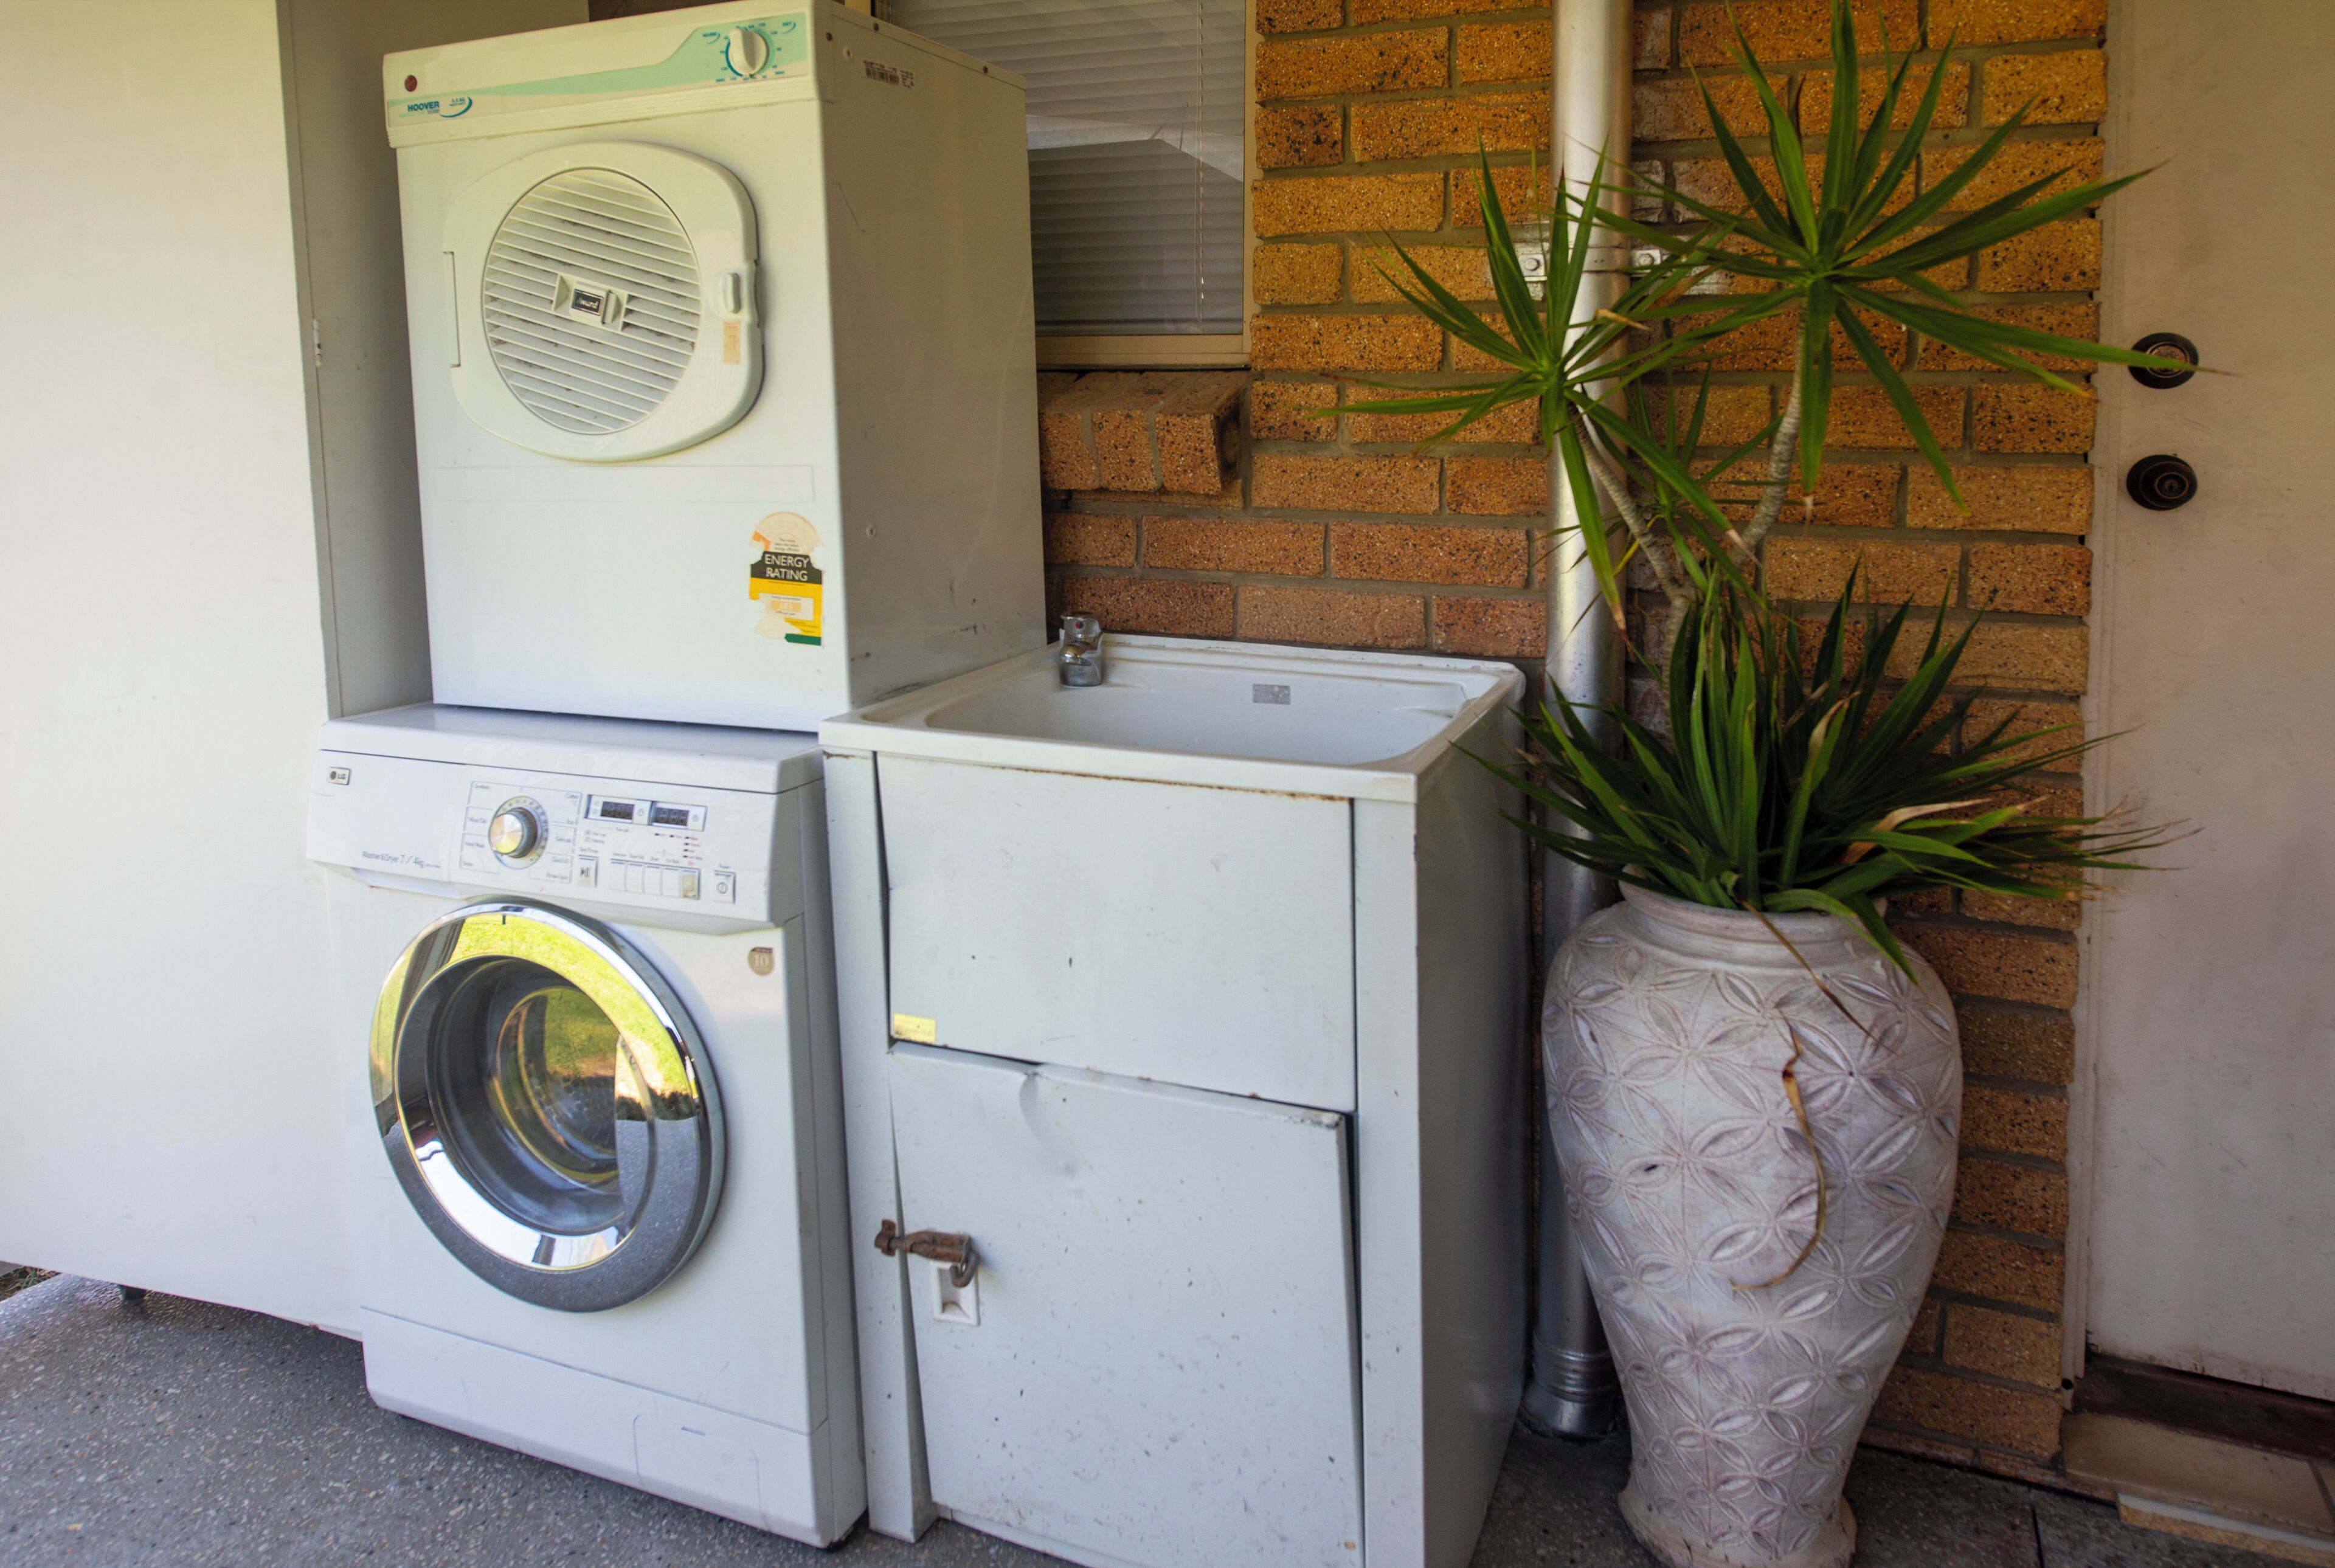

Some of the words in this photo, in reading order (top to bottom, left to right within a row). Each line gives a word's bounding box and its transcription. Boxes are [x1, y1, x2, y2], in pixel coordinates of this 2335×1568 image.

[407, 101, 440, 112] HOOVER
[764, 554, 810, 568] ENERGY
[766, 567, 808, 581] RATING
